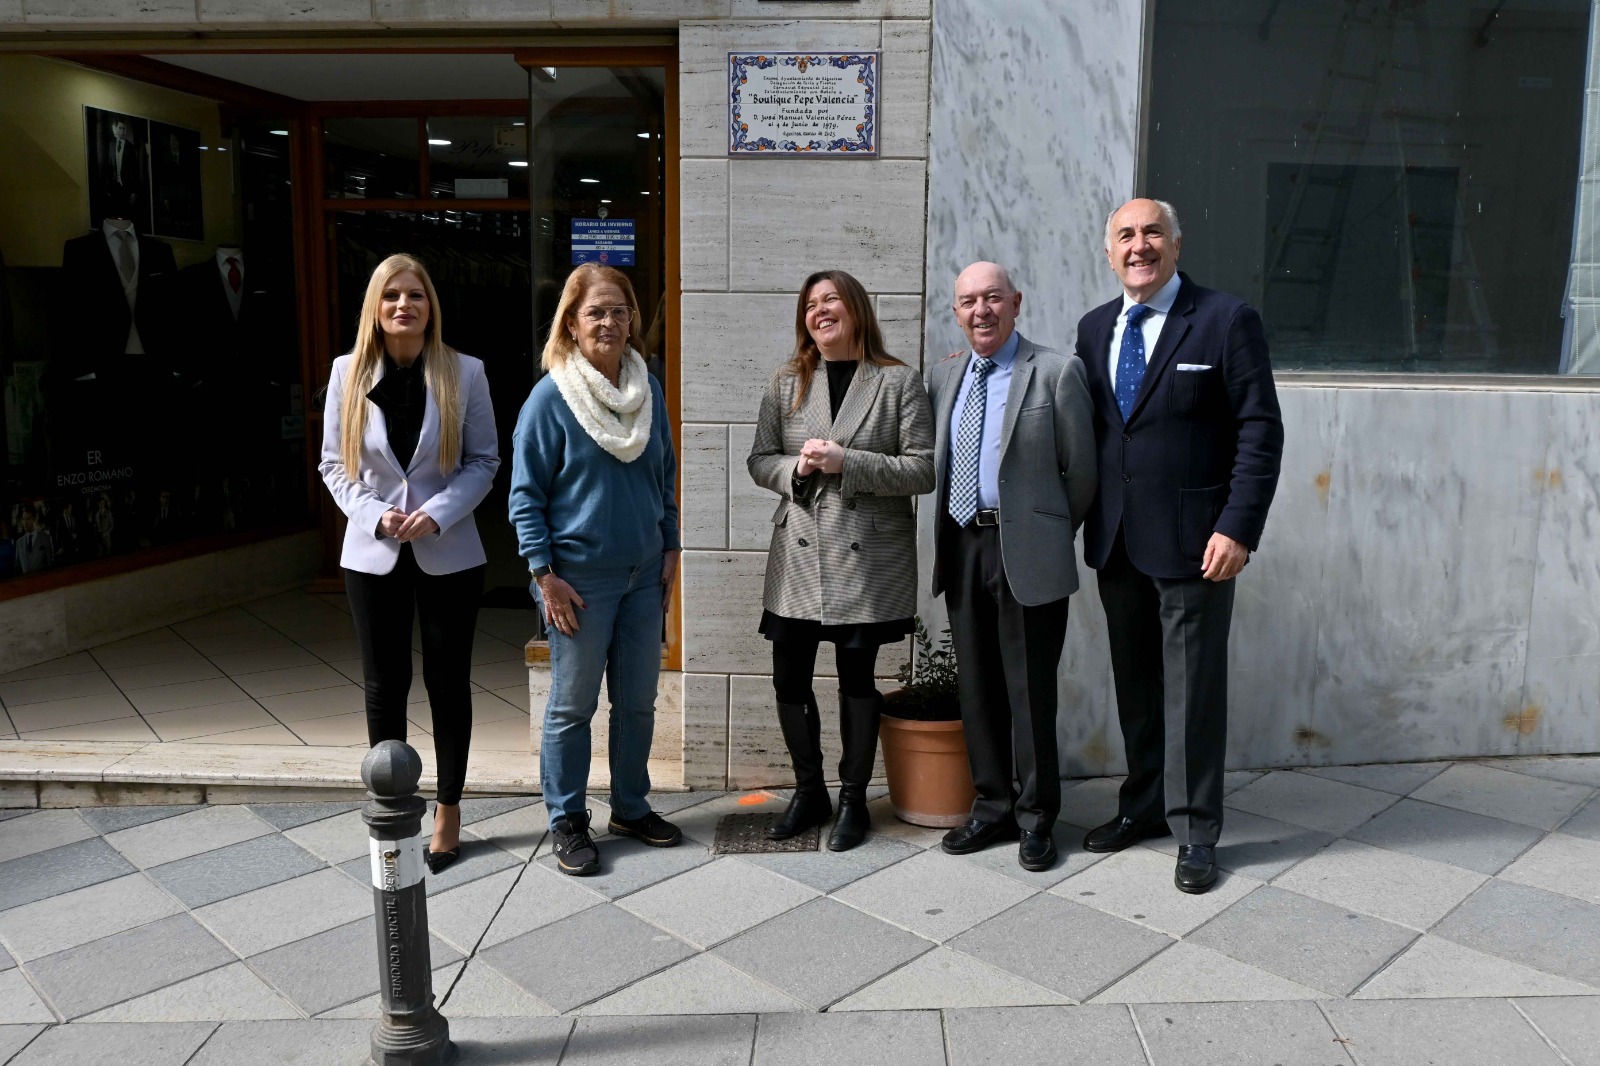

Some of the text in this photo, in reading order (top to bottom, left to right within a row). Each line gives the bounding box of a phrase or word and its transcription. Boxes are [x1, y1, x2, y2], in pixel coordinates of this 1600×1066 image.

[748, 93, 859, 106] "Boutique Pepe Valencia"
[761, 114, 777, 123] José
[87, 450, 103, 466] ER
[57, 466, 133, 487] ENZO ROMANO
[383, 850, 396, 893] BENITO
[386, 897, 400, 941] DUCTIL
